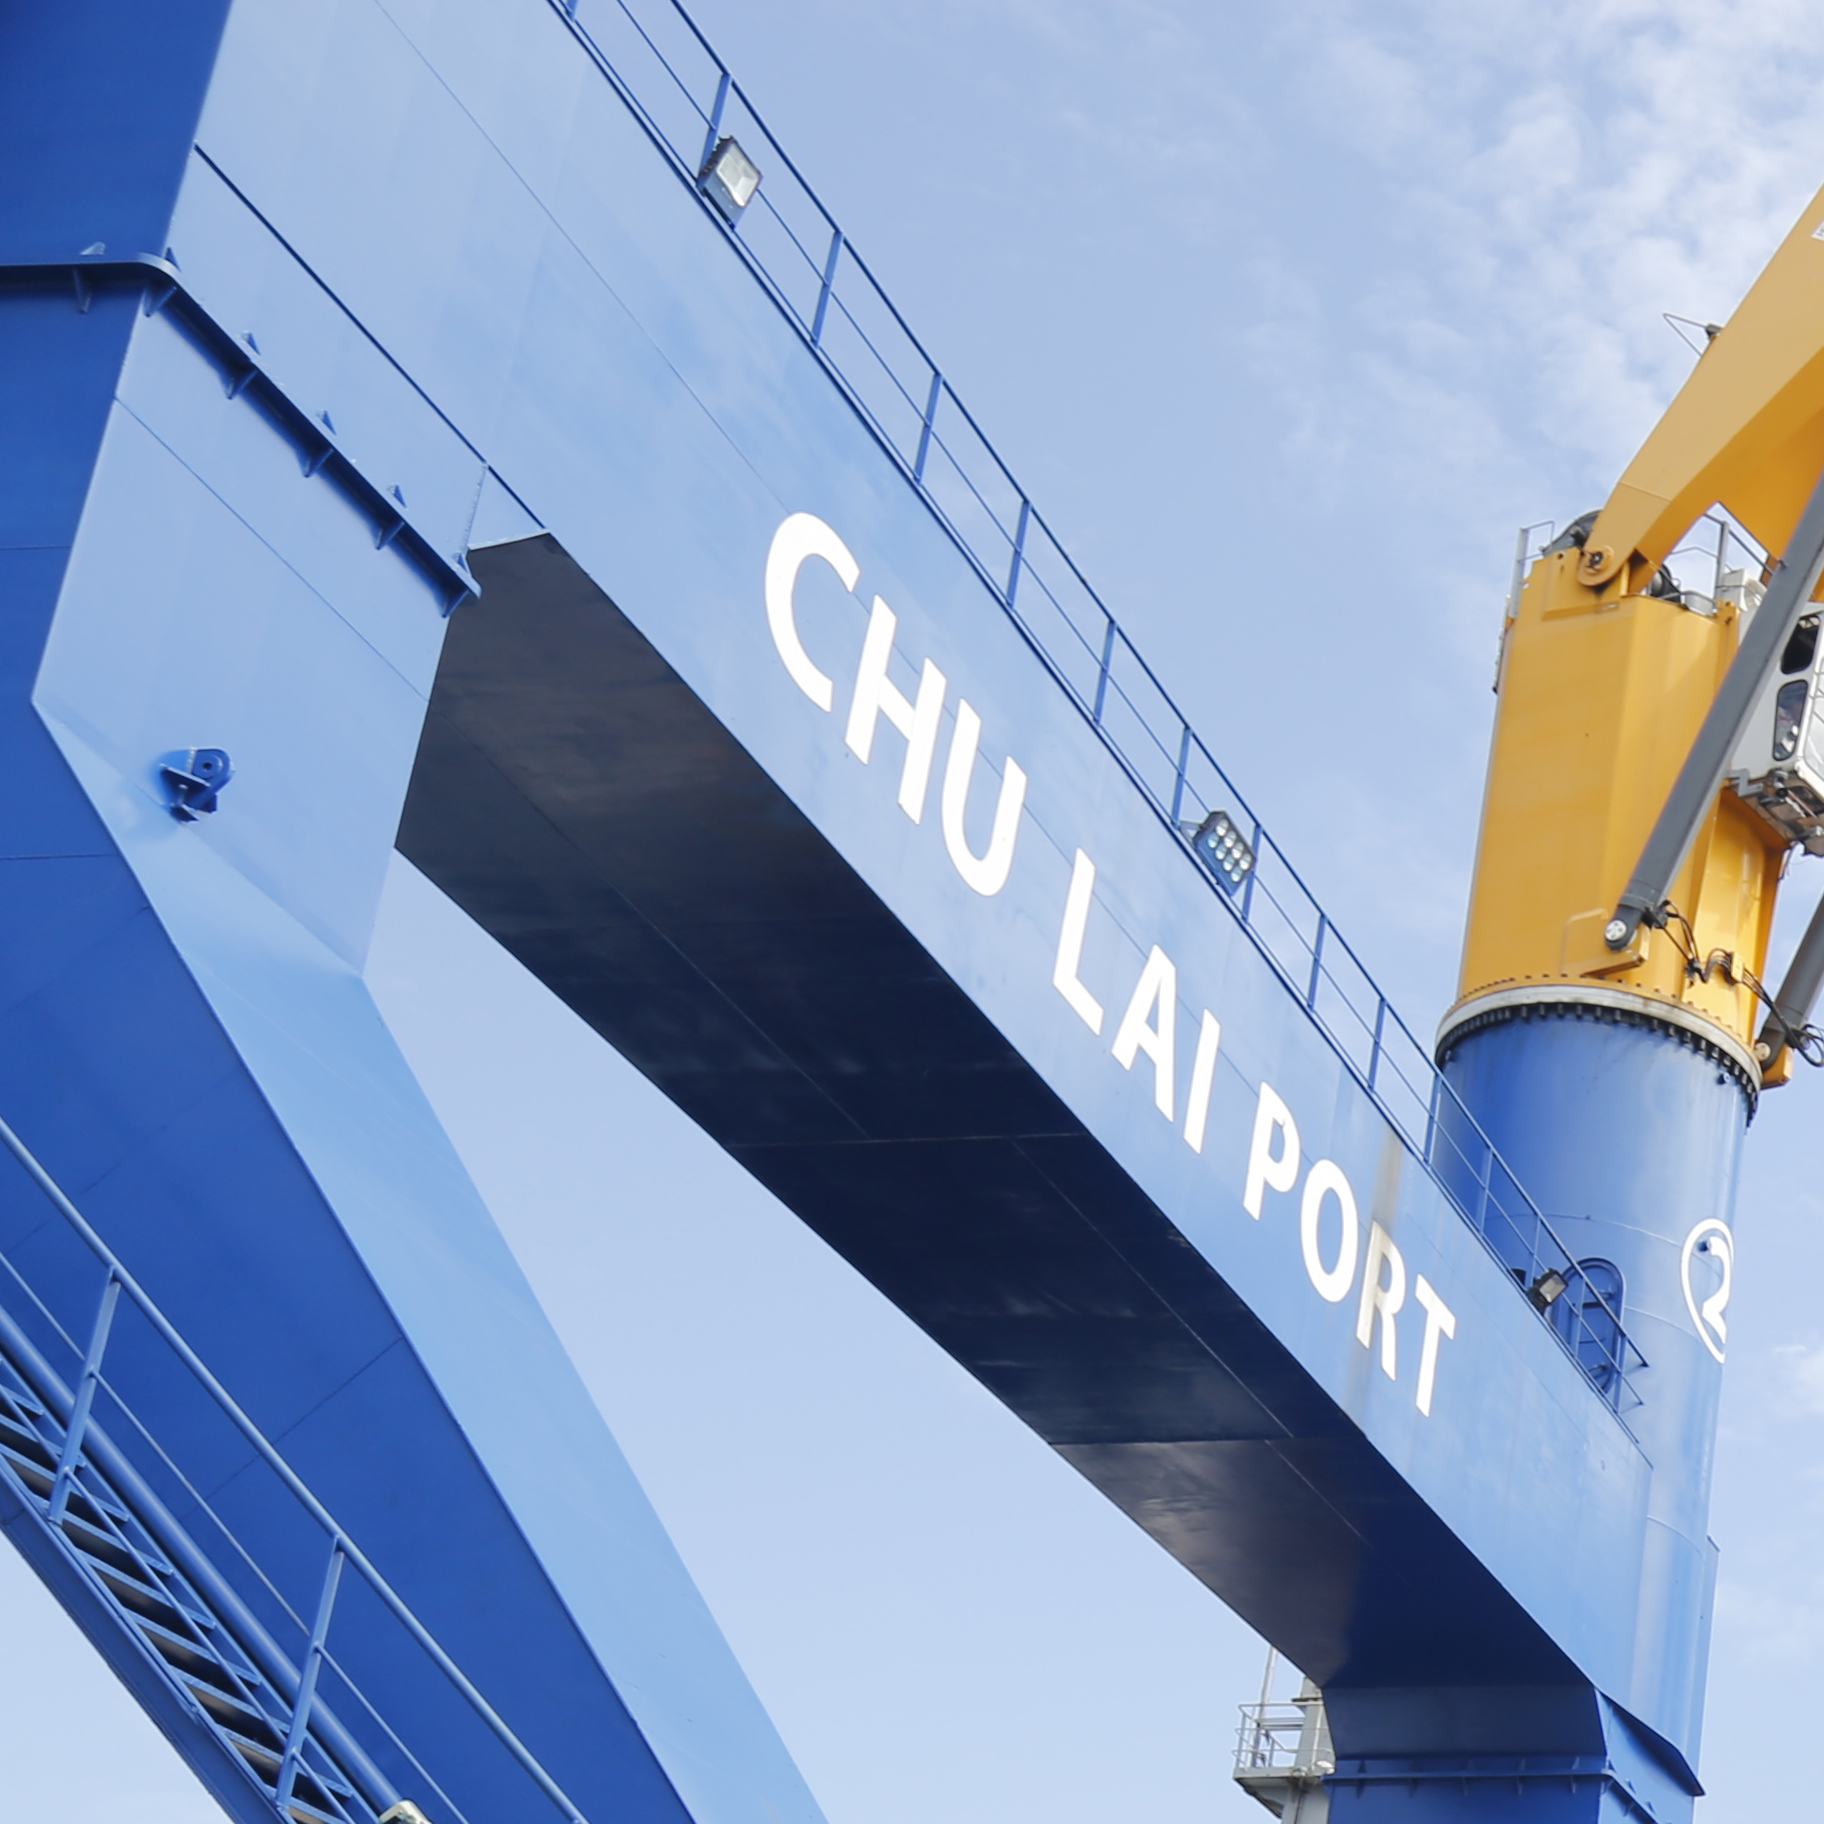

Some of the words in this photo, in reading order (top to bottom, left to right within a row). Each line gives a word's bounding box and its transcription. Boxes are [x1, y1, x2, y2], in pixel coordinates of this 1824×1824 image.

[765, 511, 1027, 897] CHU
[1053, 848, 1220, 1154] LAI
[1243, 1082, 1456, 1417] PORT
